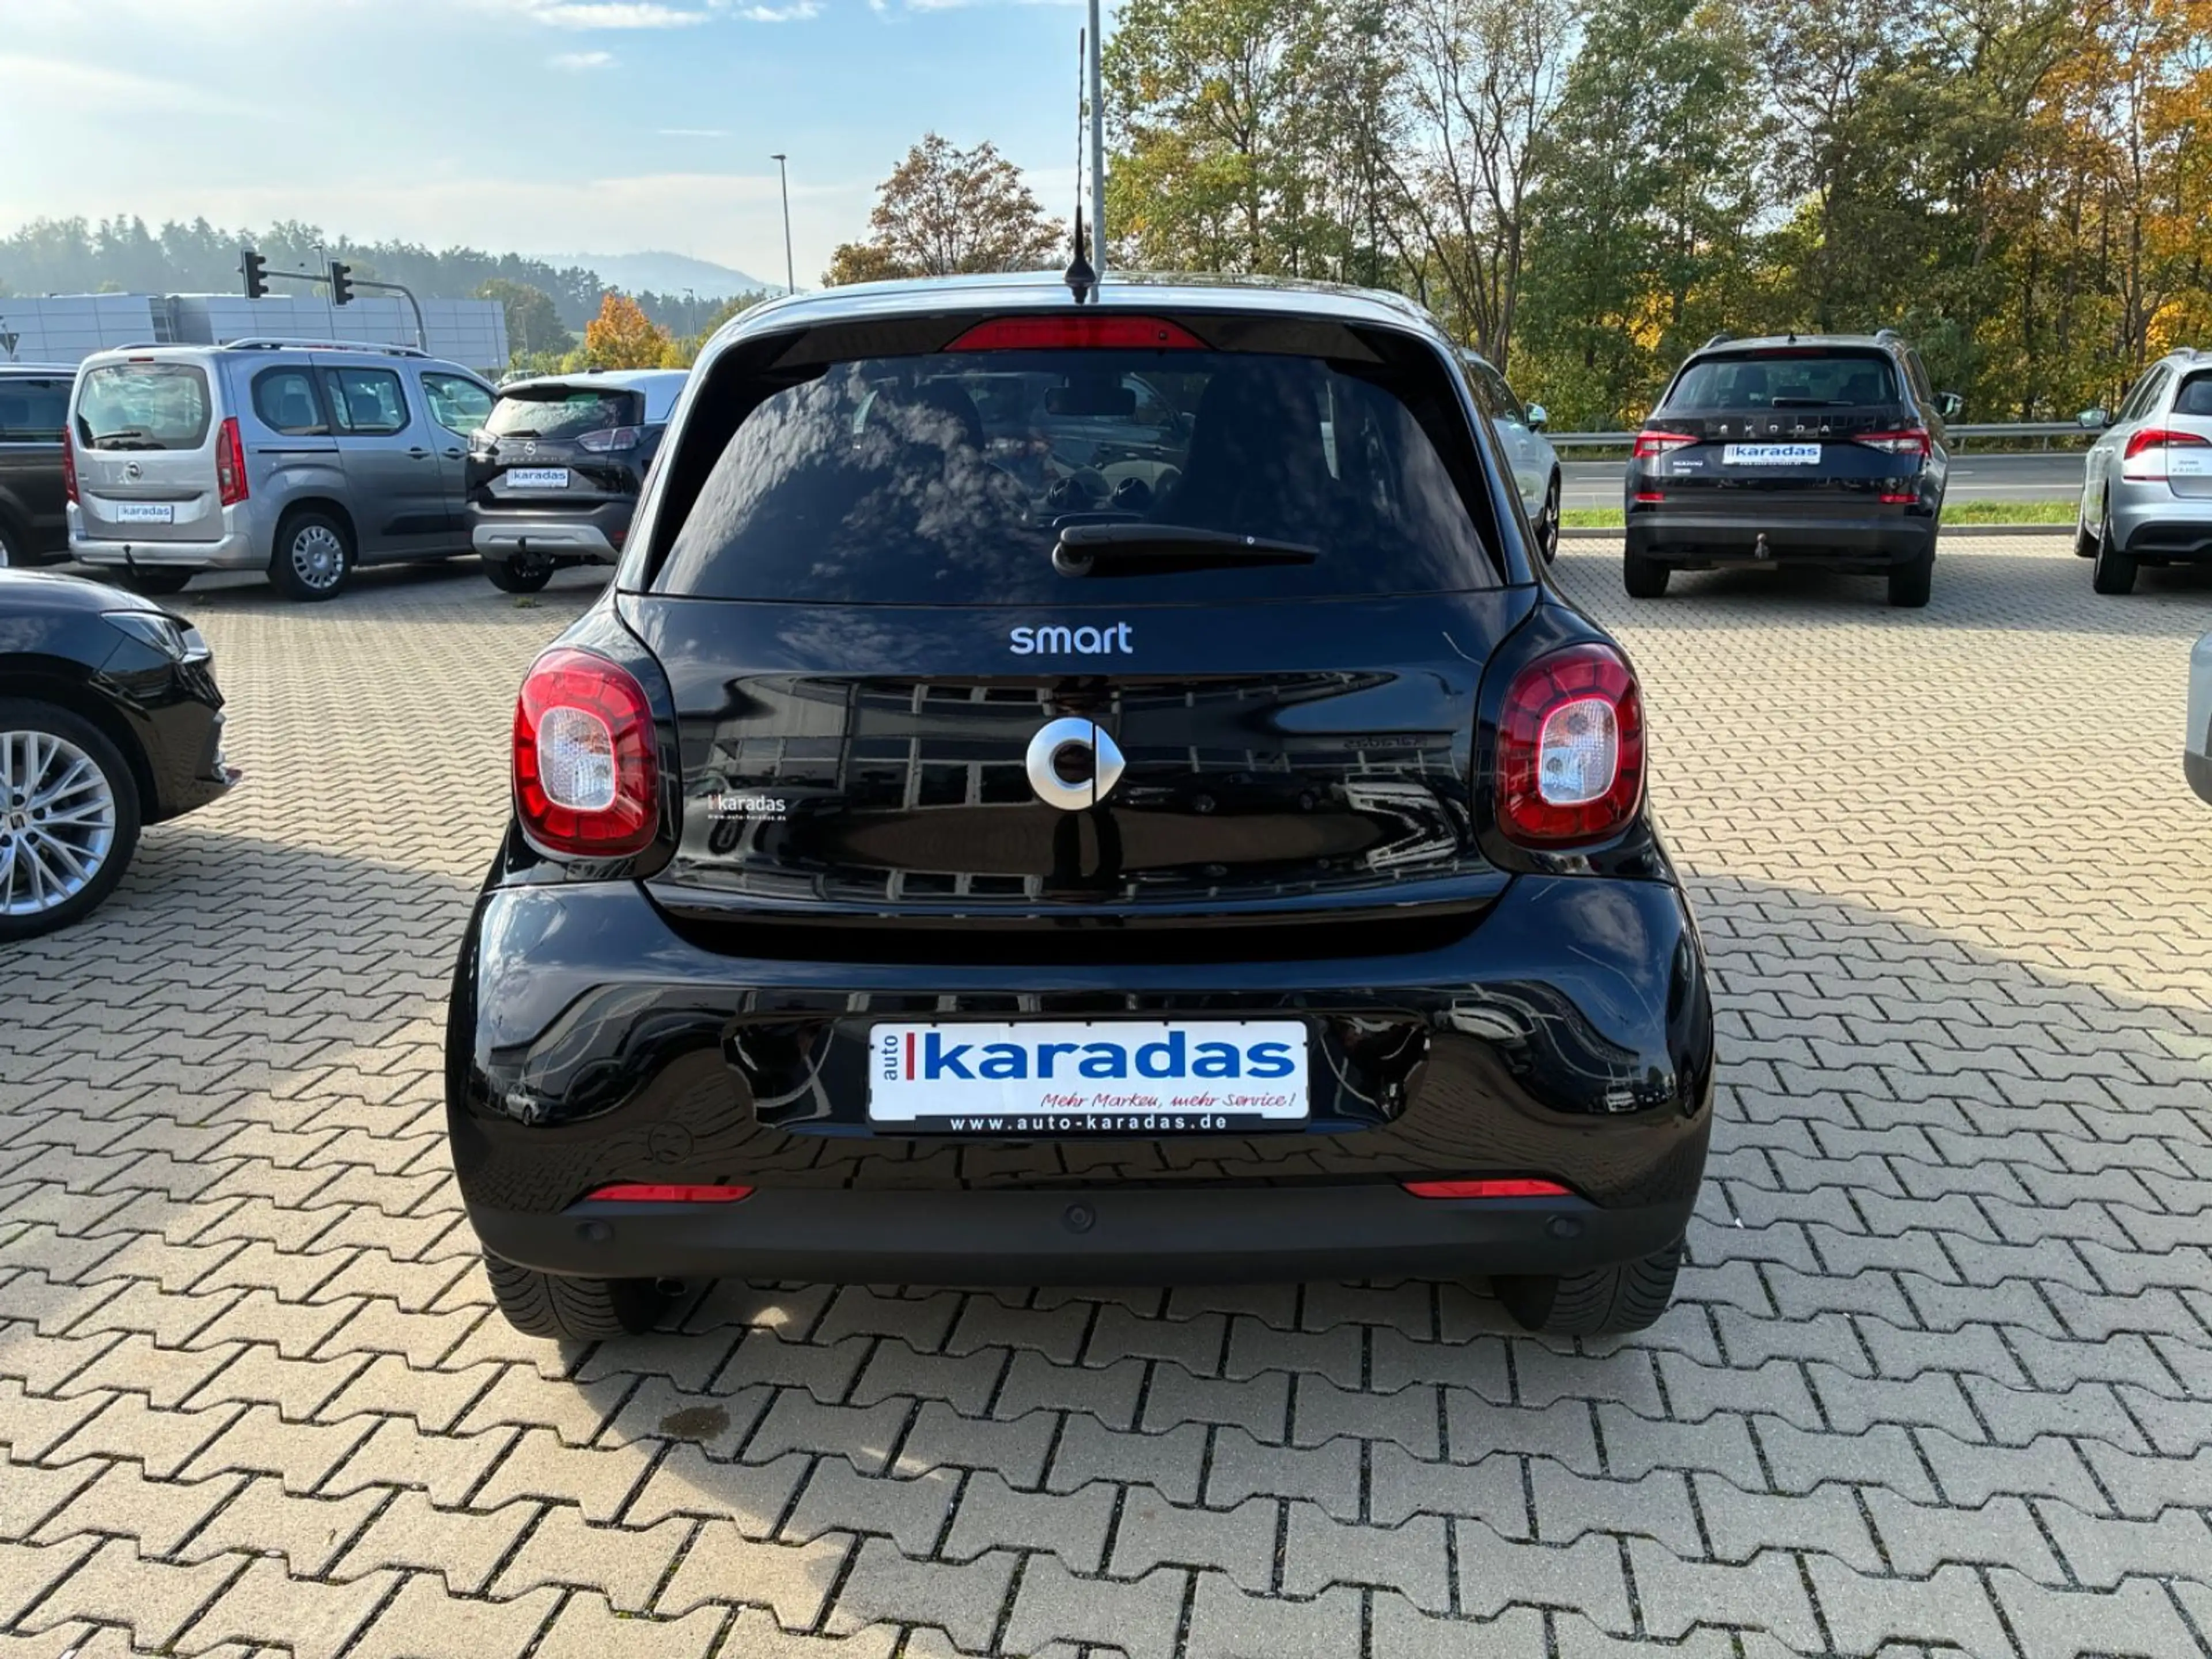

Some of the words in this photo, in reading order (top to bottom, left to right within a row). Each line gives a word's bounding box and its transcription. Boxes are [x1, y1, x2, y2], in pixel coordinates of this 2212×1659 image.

[1736, 446, 1818, 456] karadas
[514, 470, 566, 479] karadas
[123, 506, 169, 515] karadas
[1010, 621, 1134, 654] smart
[718, 794, 786, 812] karadas
[881, 1035, 898, 1081] auto
[925, 1031, 1296, 1080] karadas
[1040, 1091, 1087, 1108] Mehr
[1092, 1093, 1162, 1109] Marken,
[1169, 1090, 1220, 1107] mehr
[1222, 1092, 1297, 1107] Service!
[950, 1114, 1226, 1130] www.auto-karadas.de
